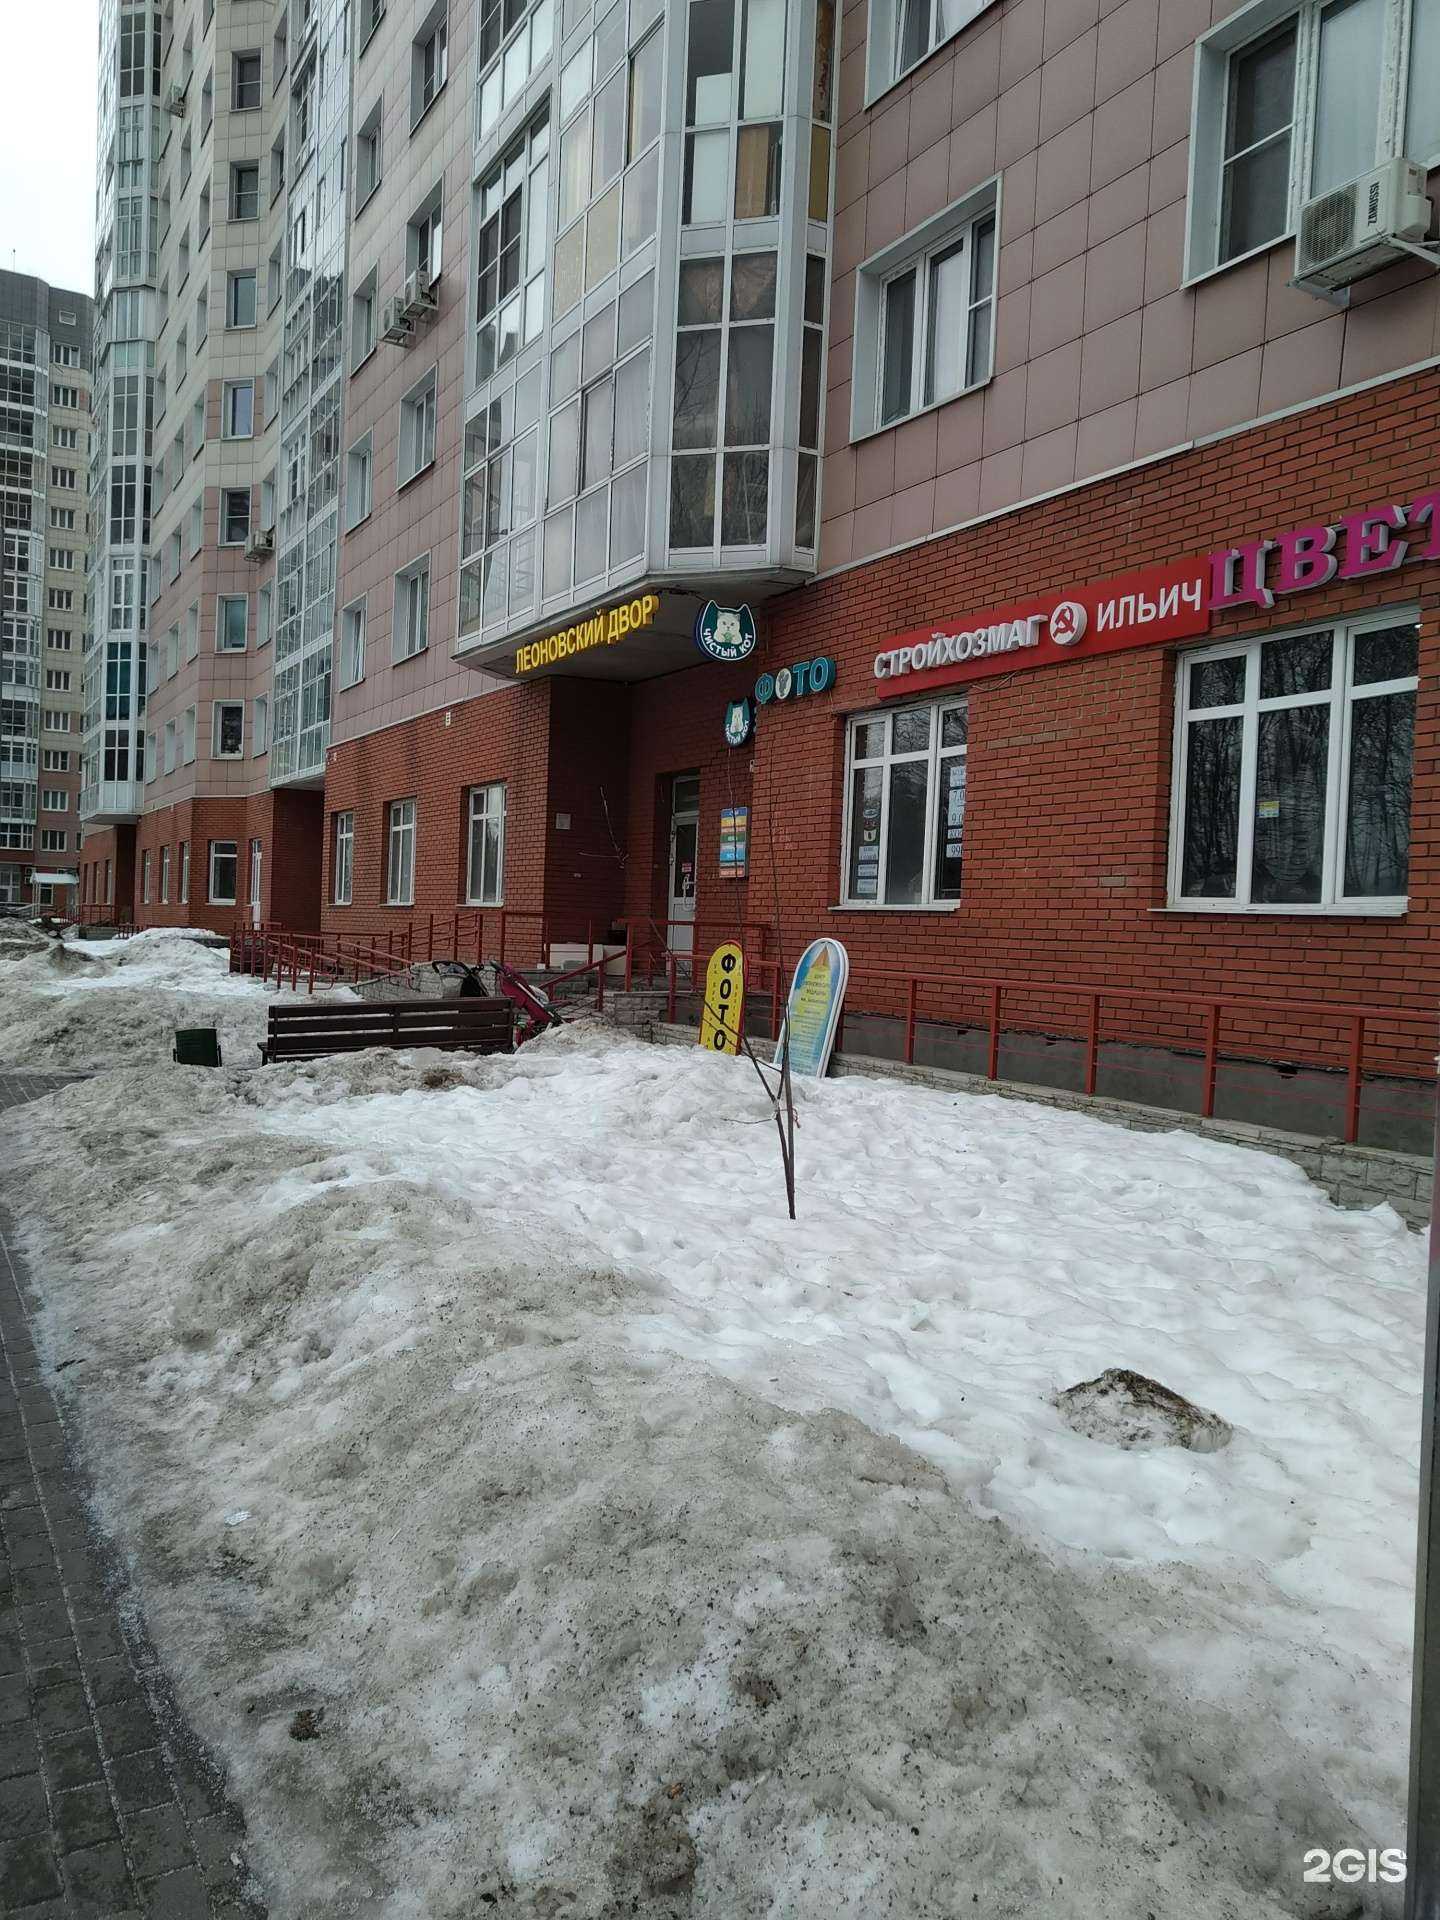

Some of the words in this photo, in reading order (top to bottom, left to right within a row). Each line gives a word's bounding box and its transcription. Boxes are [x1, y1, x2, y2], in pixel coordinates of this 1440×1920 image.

[1368, 181, 1379, 226] ZANUSSI
[515, 608, 604, 674] ЛЕОНОВСКИЙ
[607, 595, 657, 644] ДВОР
[703, 628, 737, 657] ЧИСТЫЙ
[739, 632, 753, 654] КОТ
[873, 614, 1047, 679] СТРОЙХОЗМАГ
[1096, 579, 1202, 632] ИЛЬИЧ
[755, 656, 832, 704] ФОТО
[714, 953, 737, 1051] ФОТО
